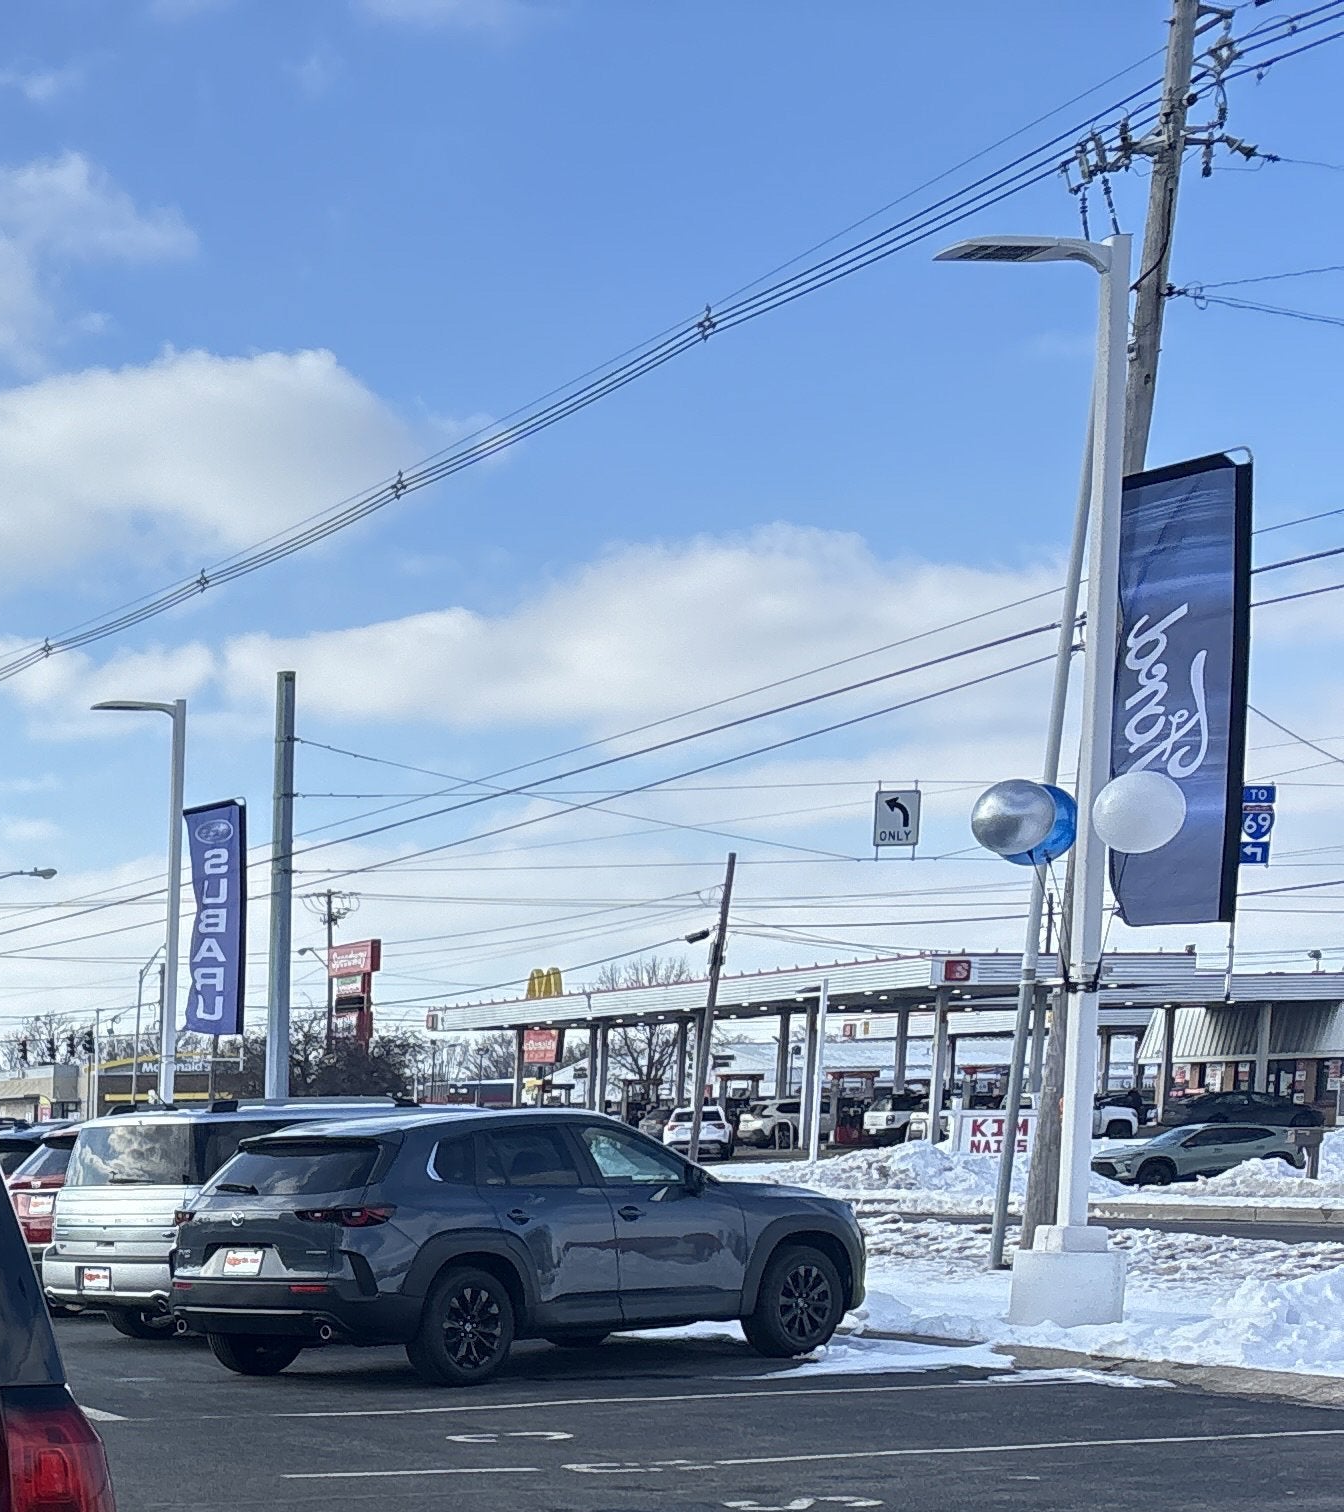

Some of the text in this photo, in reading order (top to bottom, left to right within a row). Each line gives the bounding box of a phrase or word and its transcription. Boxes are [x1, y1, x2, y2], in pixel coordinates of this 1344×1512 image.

[1249, 789, 1268, 801] TO
[1243, 812, 1272, 834] 69
[879, 830, 912, 842] ONLY
[142, 1061, 211, 1074] Mcnald's
[971, 1118, 1029, 1138] KIM
[970, 1139, 1028, 1154] NAIS
